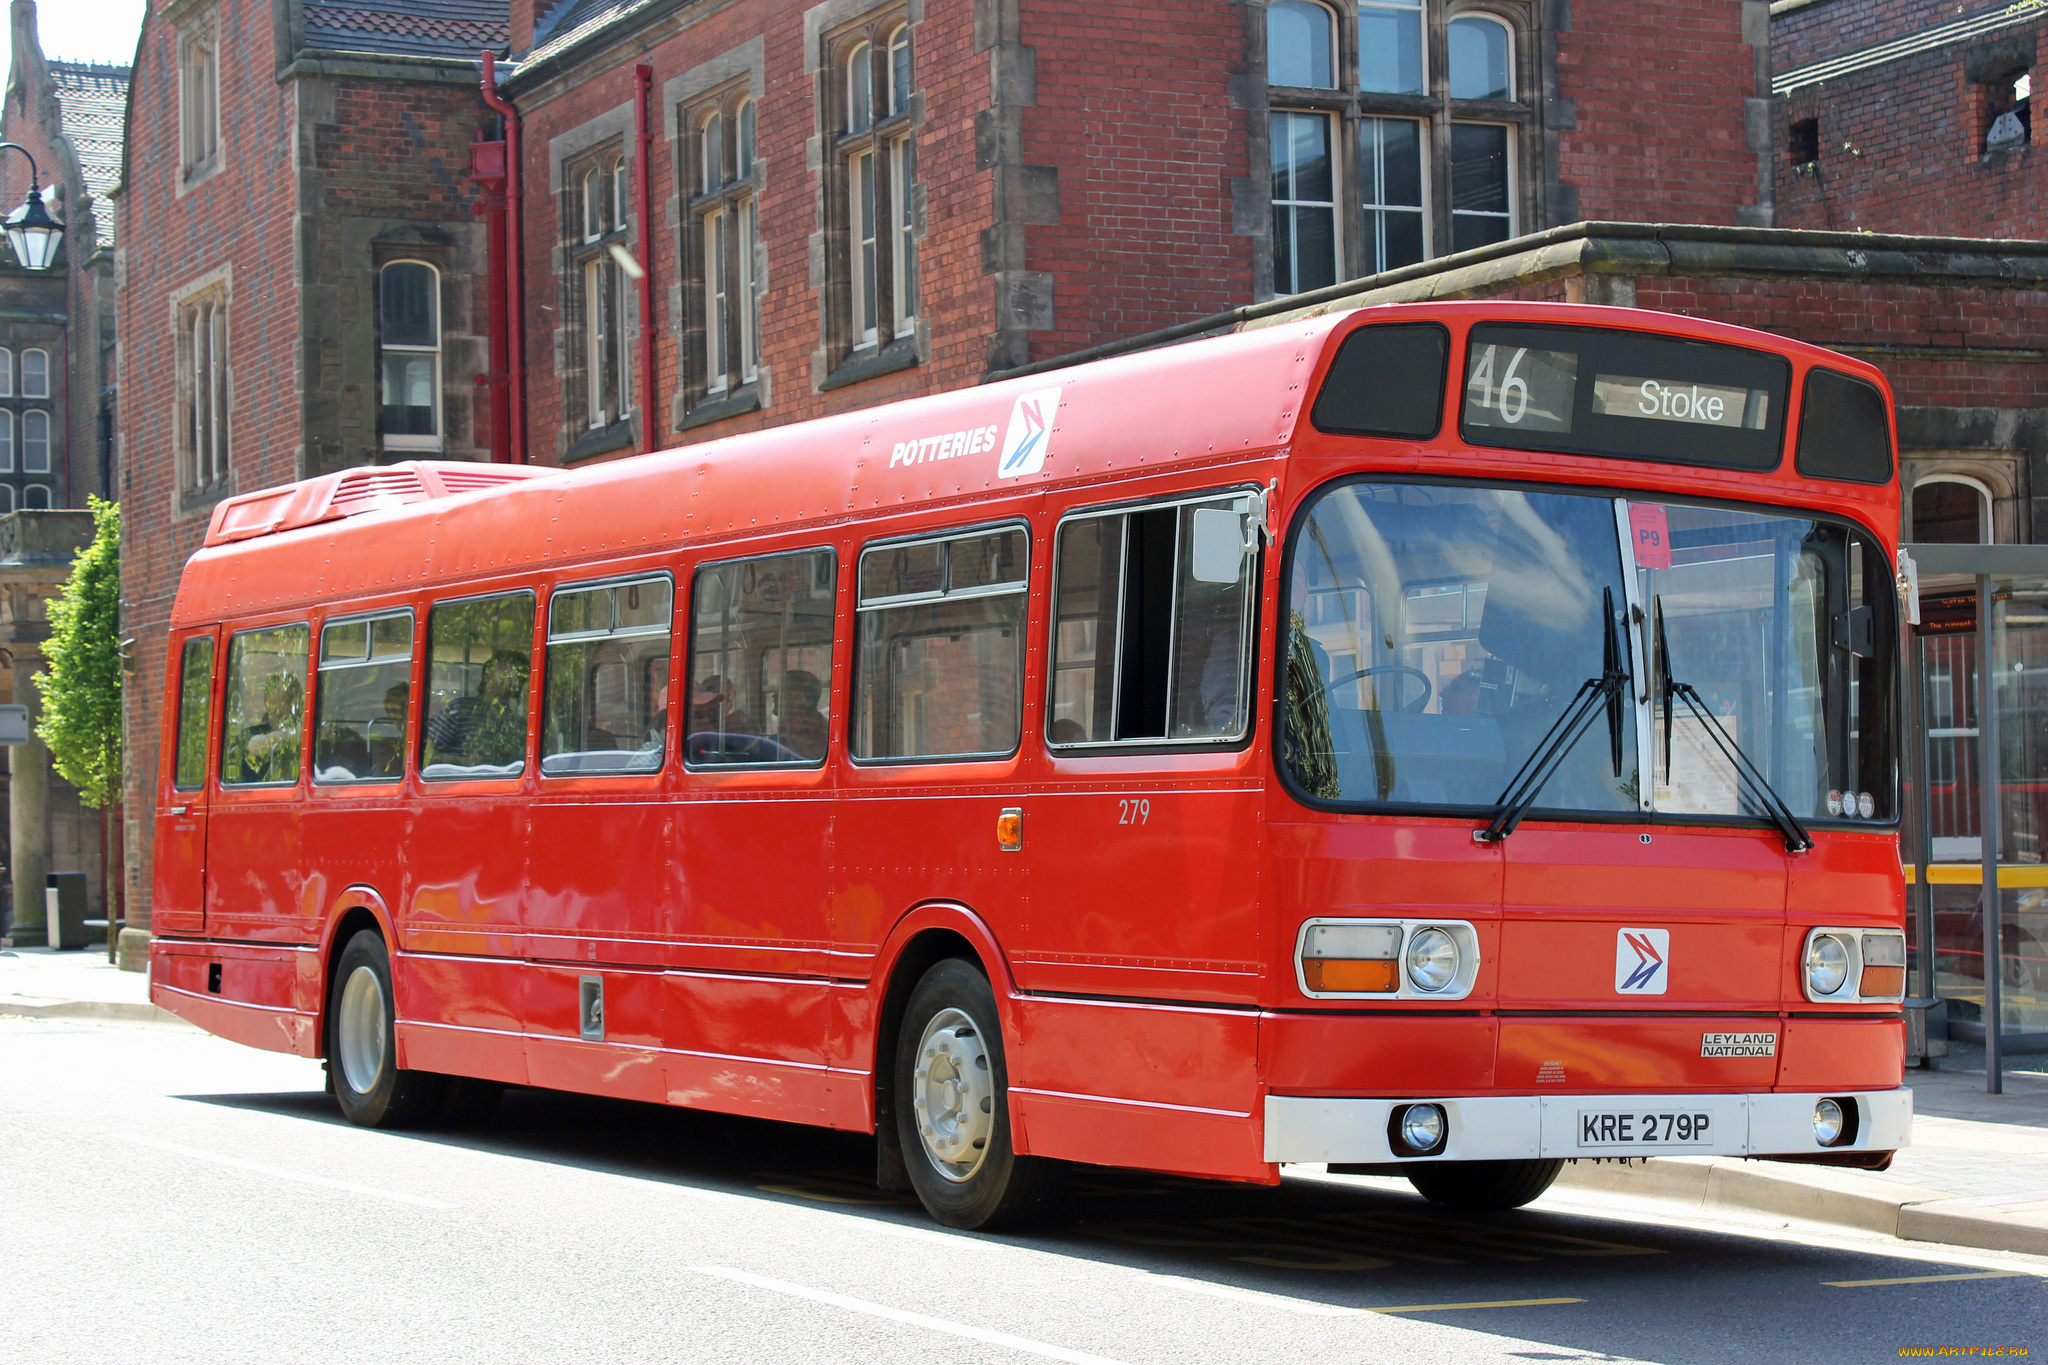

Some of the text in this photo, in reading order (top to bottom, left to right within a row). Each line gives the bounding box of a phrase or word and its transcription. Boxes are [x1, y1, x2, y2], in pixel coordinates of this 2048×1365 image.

[1468, 344, 1528, 424] 46
[1638, 380, 1724, 421] Stoke
[889, 424, 998, 469] POTTERIES
[1639, 529, 1660, 546] P9
[1118, 798, 1150, 825] 279
[1702, 1046, 1774, 1056] NATIONAL
[1704, 1034, 1775, 1044] LEYLAND
[1583, 1113, 1710, 1142] KRE 279P
